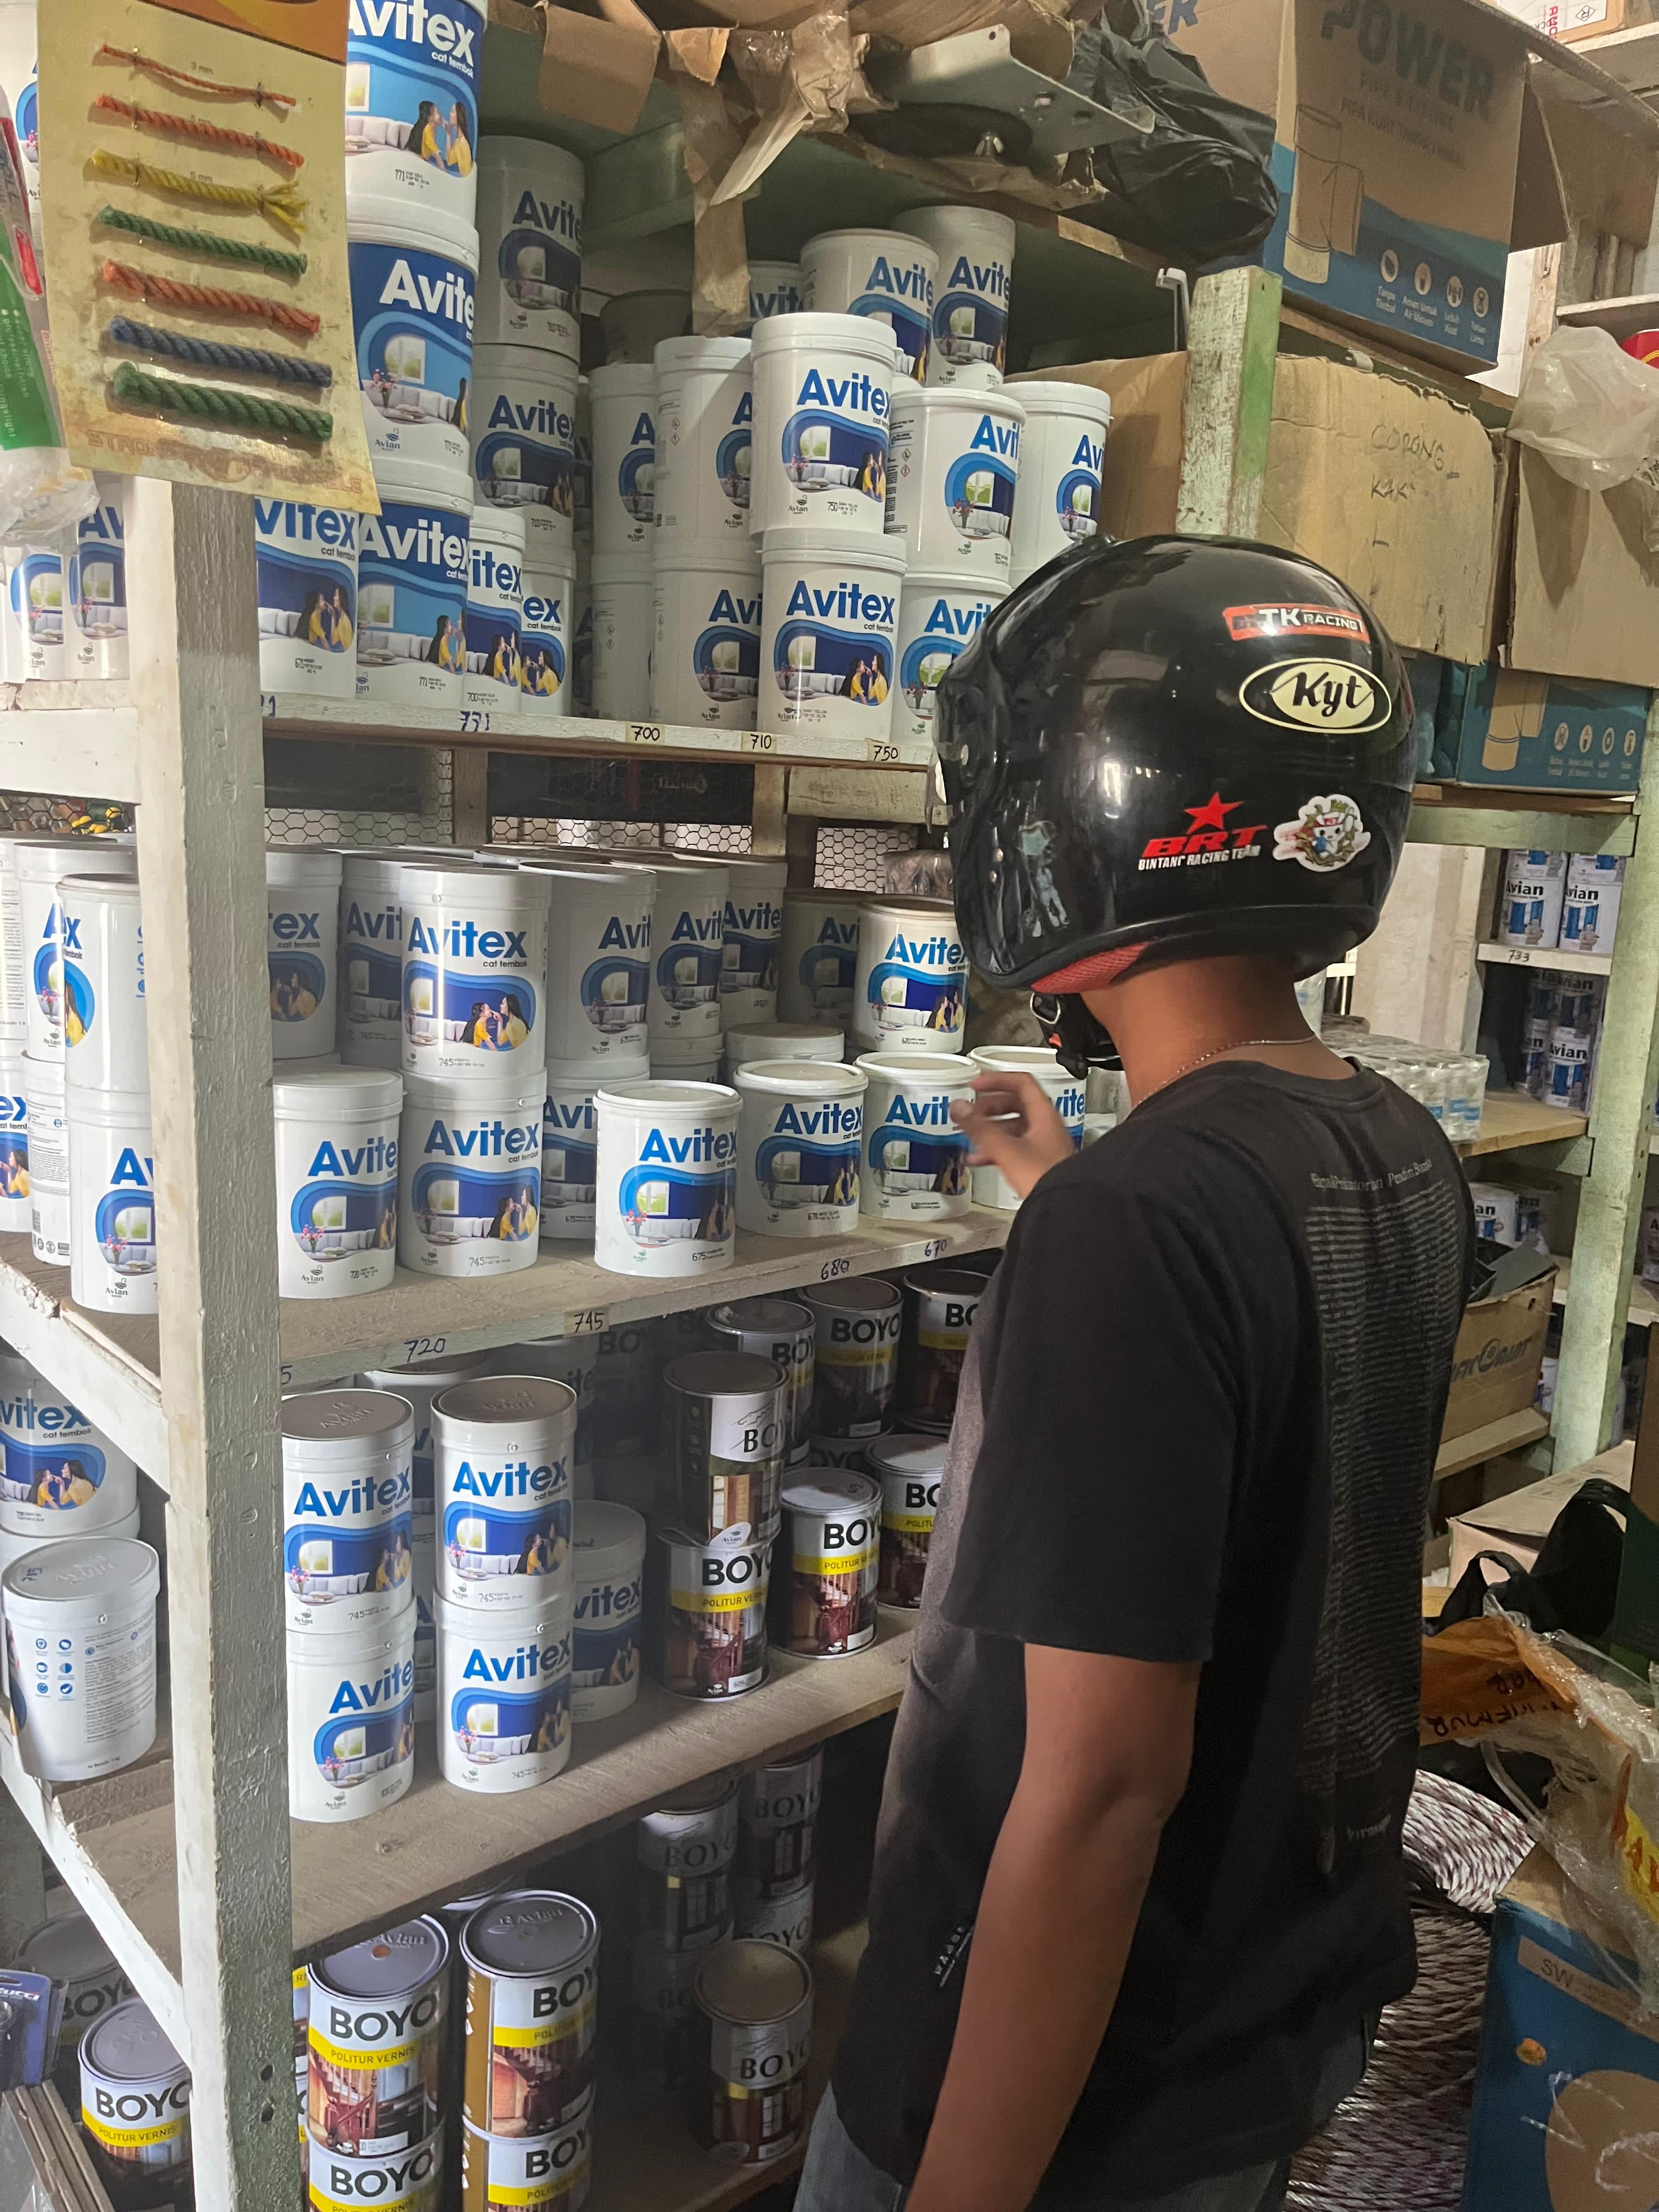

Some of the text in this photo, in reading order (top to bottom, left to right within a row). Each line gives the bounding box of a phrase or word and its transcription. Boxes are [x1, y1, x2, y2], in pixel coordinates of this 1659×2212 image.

[431, 50, 474, 78] cat tembok
[374, 438, 400, 450] Avian
[788, 505, 808, 514] Avian
[827, 501, 838, 513] 750
[321, 545, 334, 557] cat
[446, 568, 457, 579] cat
[786, 580, 895, 625] Avitex
[528, 623, 561, 633] cat tembok
[864, 623, 875, 631] cat
[1304, 613, 1359, 632] RACING
[419, 676, 428, 687] 771
[467, 692, 478, 703] 700
[1292, 670, 1362, 718] Kyt
[630, 726, 660, 743] 700
[752, 733, 772, 750] 710
[873, 745, 899, 761] 750
[1142, 825, 1267, 857] BRT
[1186, 850, 1229, 866] RACING
[408, 916, 528, 959] Avitex
[1508, 949, 1530, 962] 733
[499, 960, 527, 968] tembok
[439, 1058, 453, 1068] 745
[424, 1120, 539, 1156] Avitex
[924, 1239, 947, 1257] 670
[469, 1256, 485, 1267] 745
[692, 1251, 707, 1262] 675
[821, 1259, 849, 1280] 680
[105, 1287, 128, 1296] Avian
[574, 1312, 605, 1334] 745
[404, 1338, 447, 1363] 720
[59, 1427, 92, 1438] tembok
[452, 1454, 568, 1497] Avitex
[294, 1465, 410, 1517] Avitex
[534, 1493, 547, 1502] cat
[381, 1506, 393, 1516] cat
[825, 1559, 859, 1571] POLITUR
[478, 1592, 494, 1602] 745
[702, 1595, 742, 1609] POLITUR
[349, 1610, 365, 1620] 745
[330, 1994, 437, 2041] BOYO
[331, 2046, 415, 2065] POLITUR VERNIS
[98, 2124, 176, 2142] POLITUR VERNIS
[330, 2146, 434, 2198] BOYO
